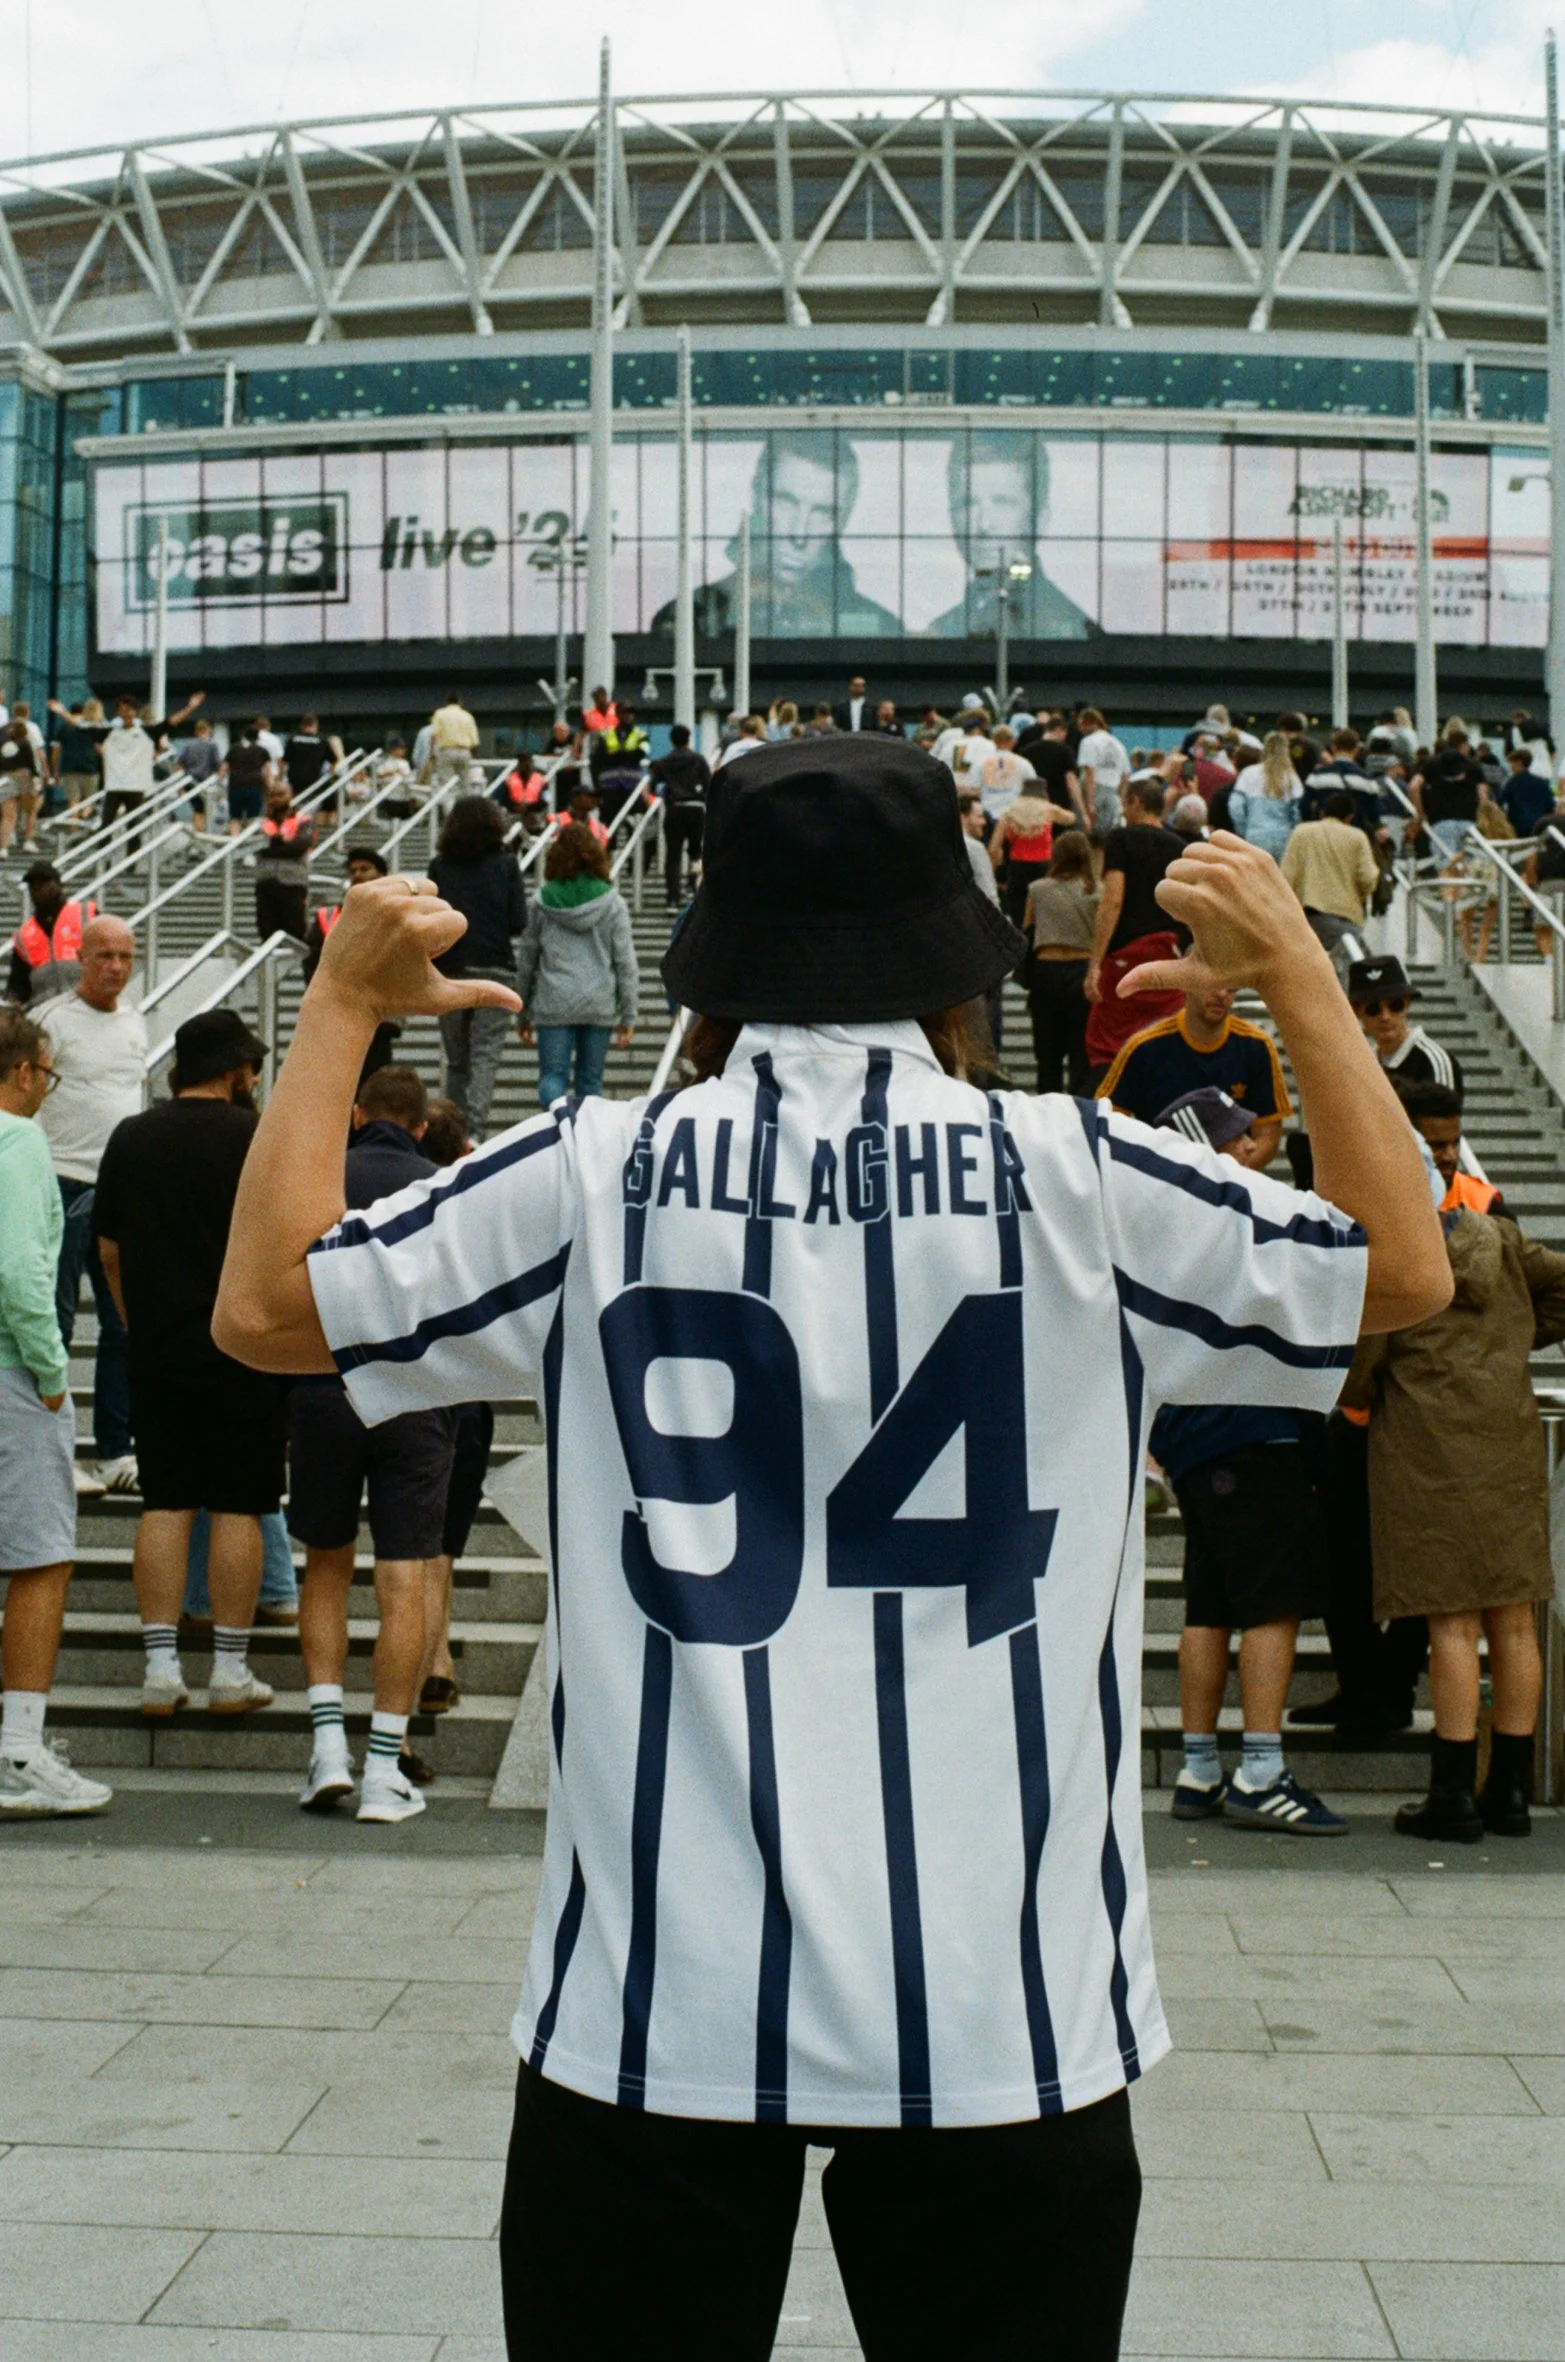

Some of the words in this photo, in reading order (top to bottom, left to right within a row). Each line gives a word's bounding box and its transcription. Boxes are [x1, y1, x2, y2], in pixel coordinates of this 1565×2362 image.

[146, 517, 324, 582] oasis
[380, 515, 497, 571] live
[622, 1116, 1034, 1227] GALLAGHER
[599, 1285, 1061, 1649] 94
